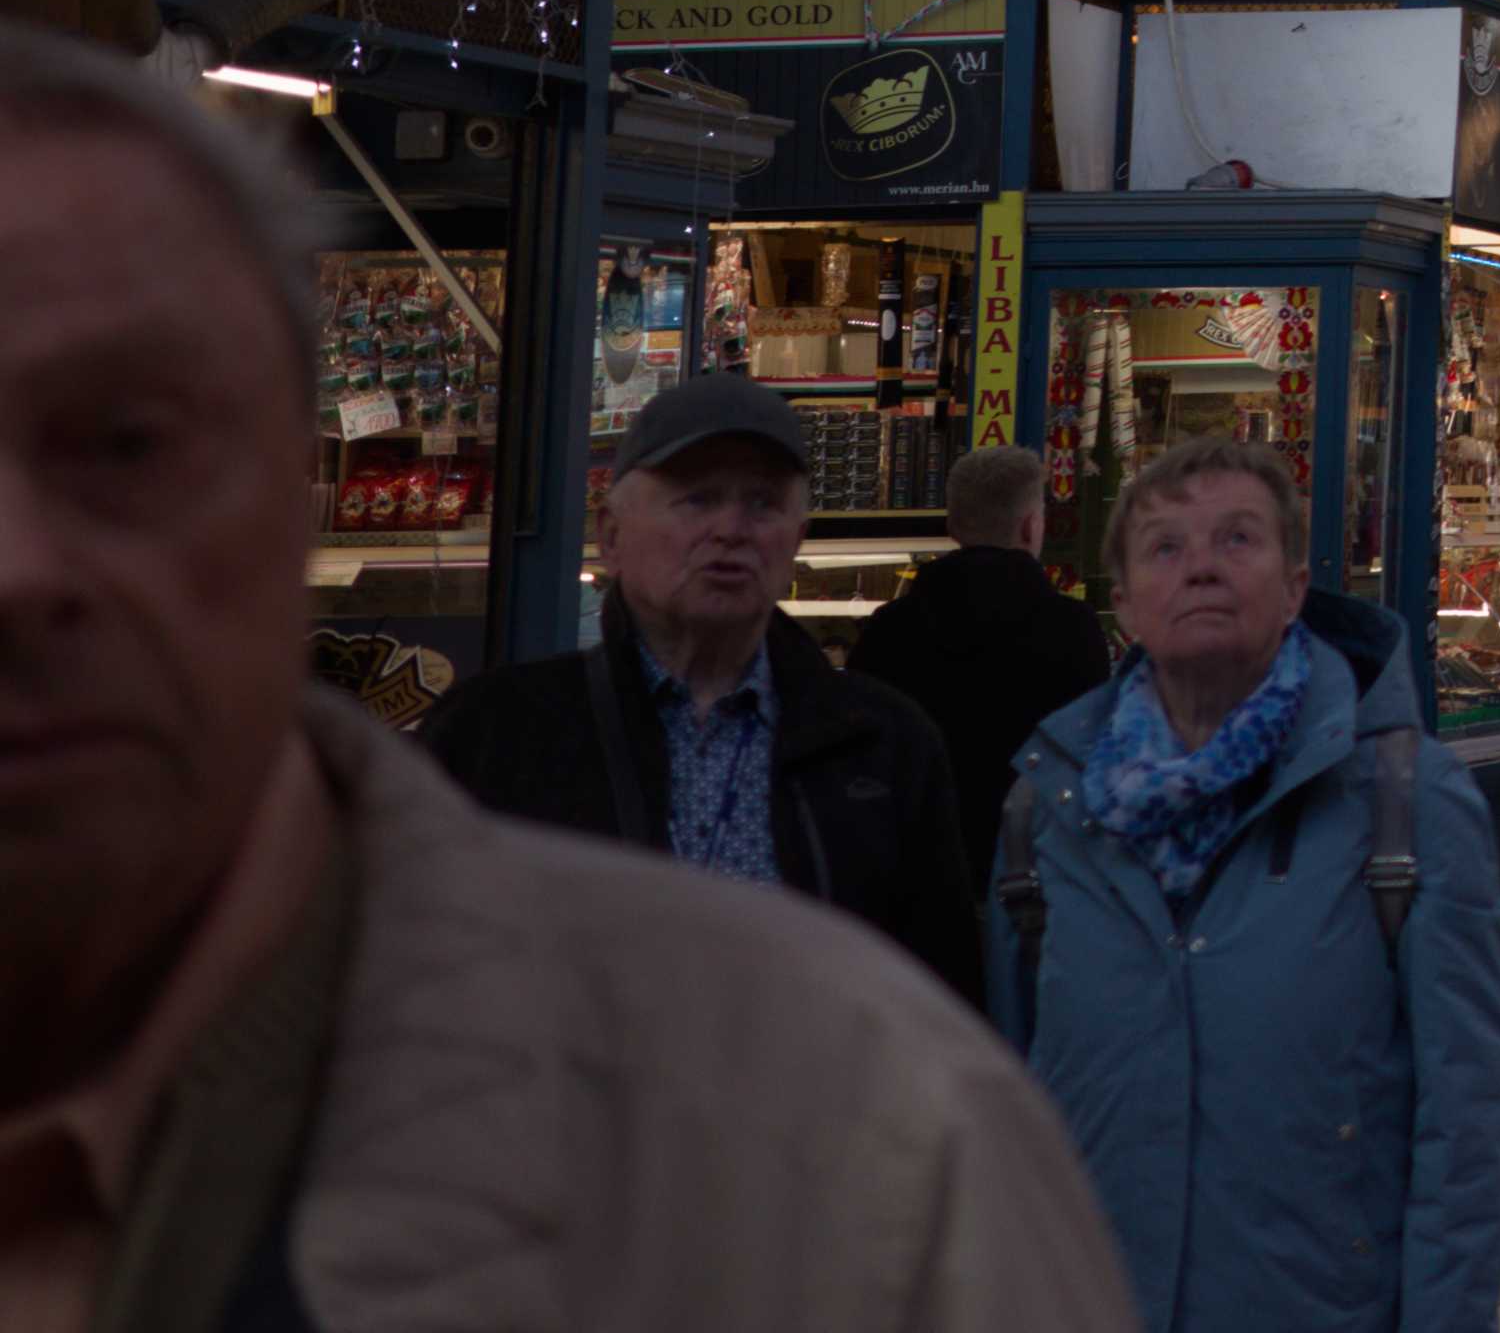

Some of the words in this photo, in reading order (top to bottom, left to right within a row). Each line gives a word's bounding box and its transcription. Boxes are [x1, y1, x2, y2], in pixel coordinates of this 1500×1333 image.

[666, 6, 732, 29] AND
[748, 3, 834, 26] GOLD
[868, 106, 943, 153] CIBORUM
[888, 181, 990, 195] www.merian.hu
[976, 234, 1016, 447] LIBA-MÁ
